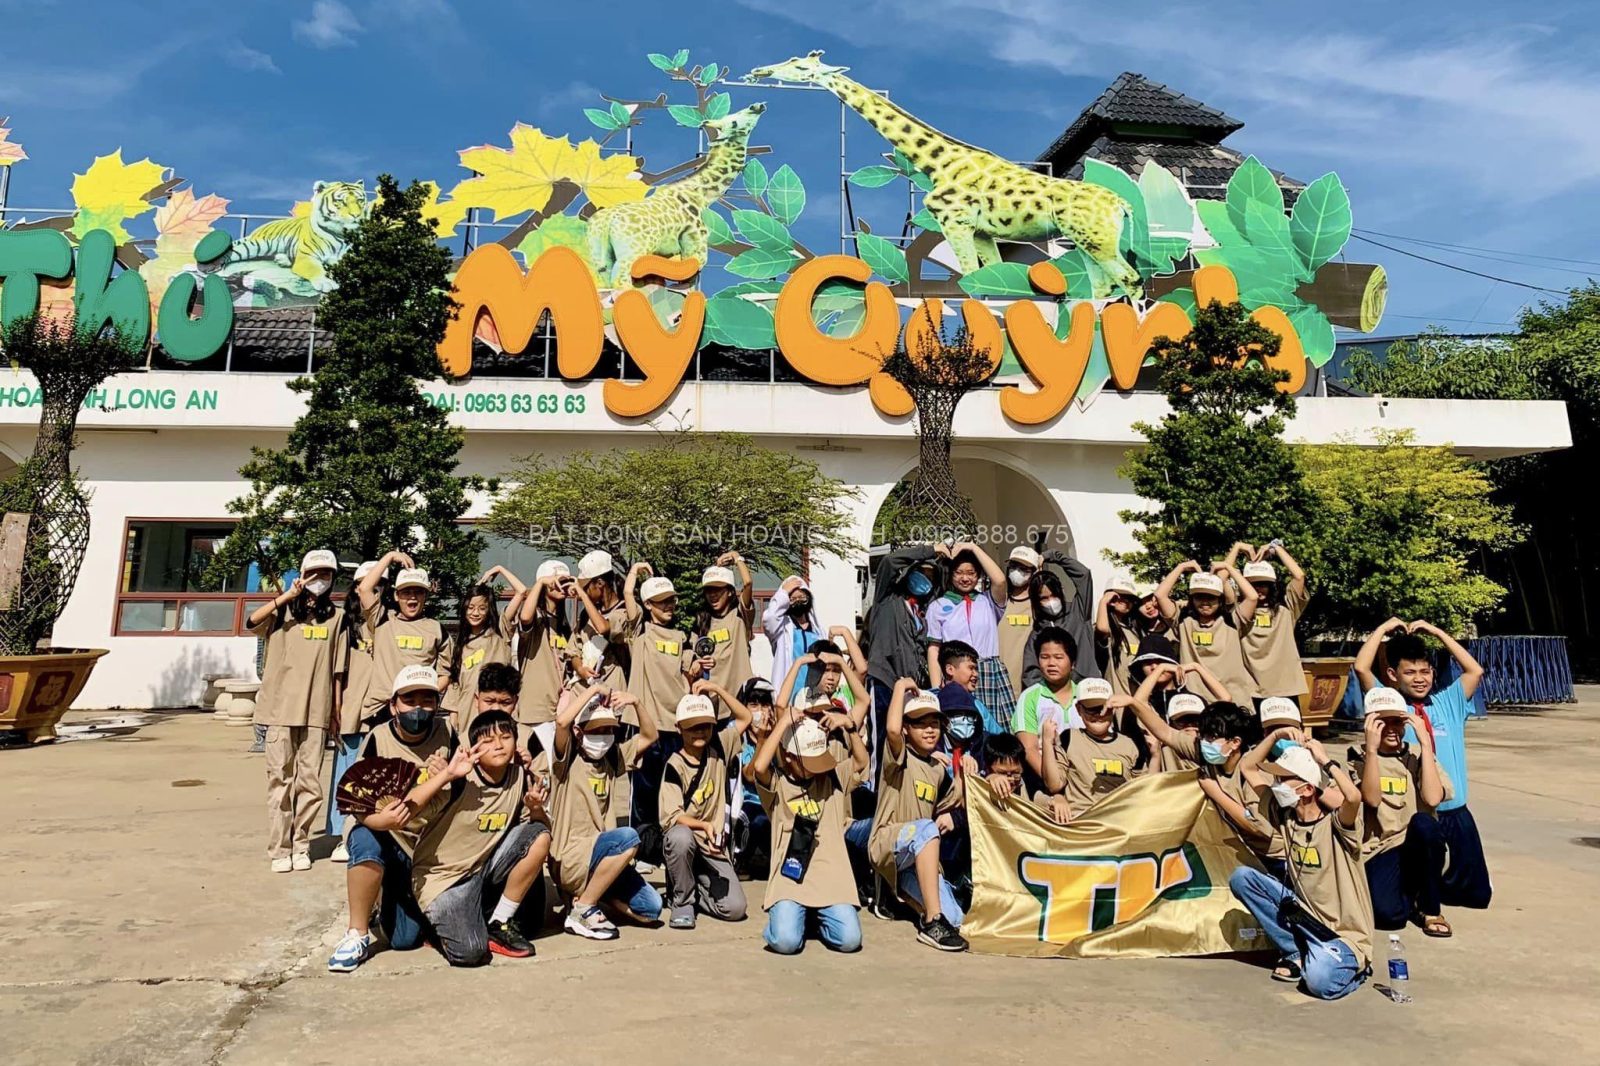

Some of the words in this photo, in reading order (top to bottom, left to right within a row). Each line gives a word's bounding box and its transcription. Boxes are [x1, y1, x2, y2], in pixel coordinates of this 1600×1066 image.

[437, 243, 705, 417] Mỹ
[115, 388, 176, 410] LONG
[185, 390, 218, 410] AN
[464, 392, 507, 413] 0963
[510, 393, 532, 413] 63
[537, 393, 559, 413] 63
[564, 393, 586, 414] 63
